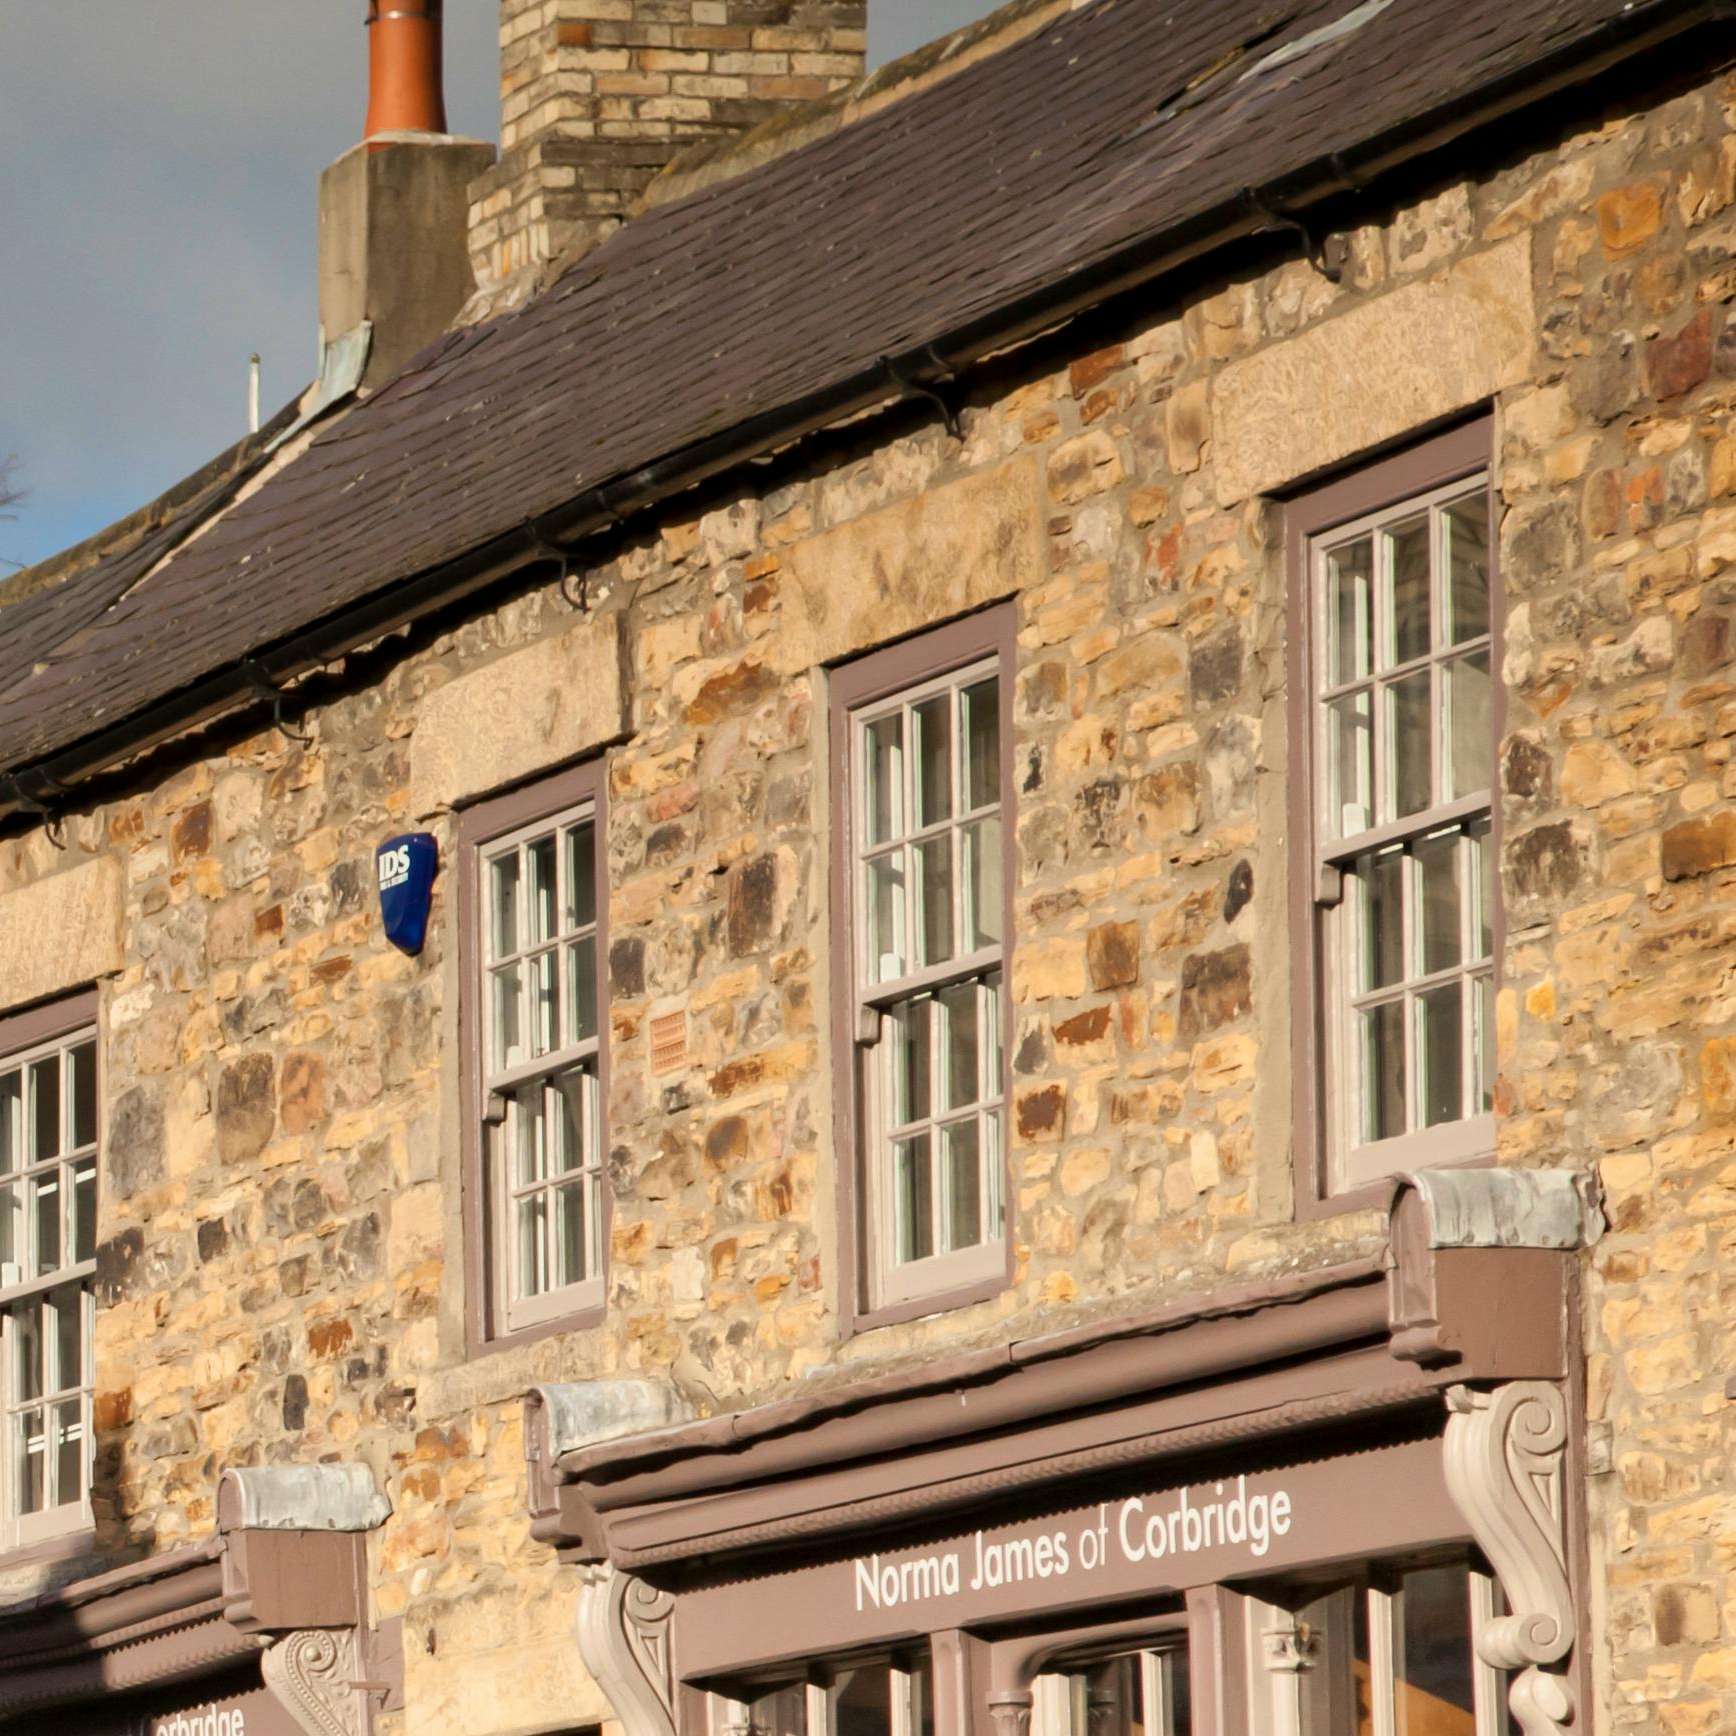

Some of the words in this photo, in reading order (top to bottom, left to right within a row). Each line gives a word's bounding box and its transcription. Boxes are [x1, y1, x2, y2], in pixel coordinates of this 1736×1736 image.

[379, 844, 411, 881] IDS
[853, 1553, 960, 1611] Norma
[970, 1530, 1069, 1591] James
[1079, 1501, 1109, 1570] of
[1119, 1474, 1292, 1562] Corbridge
